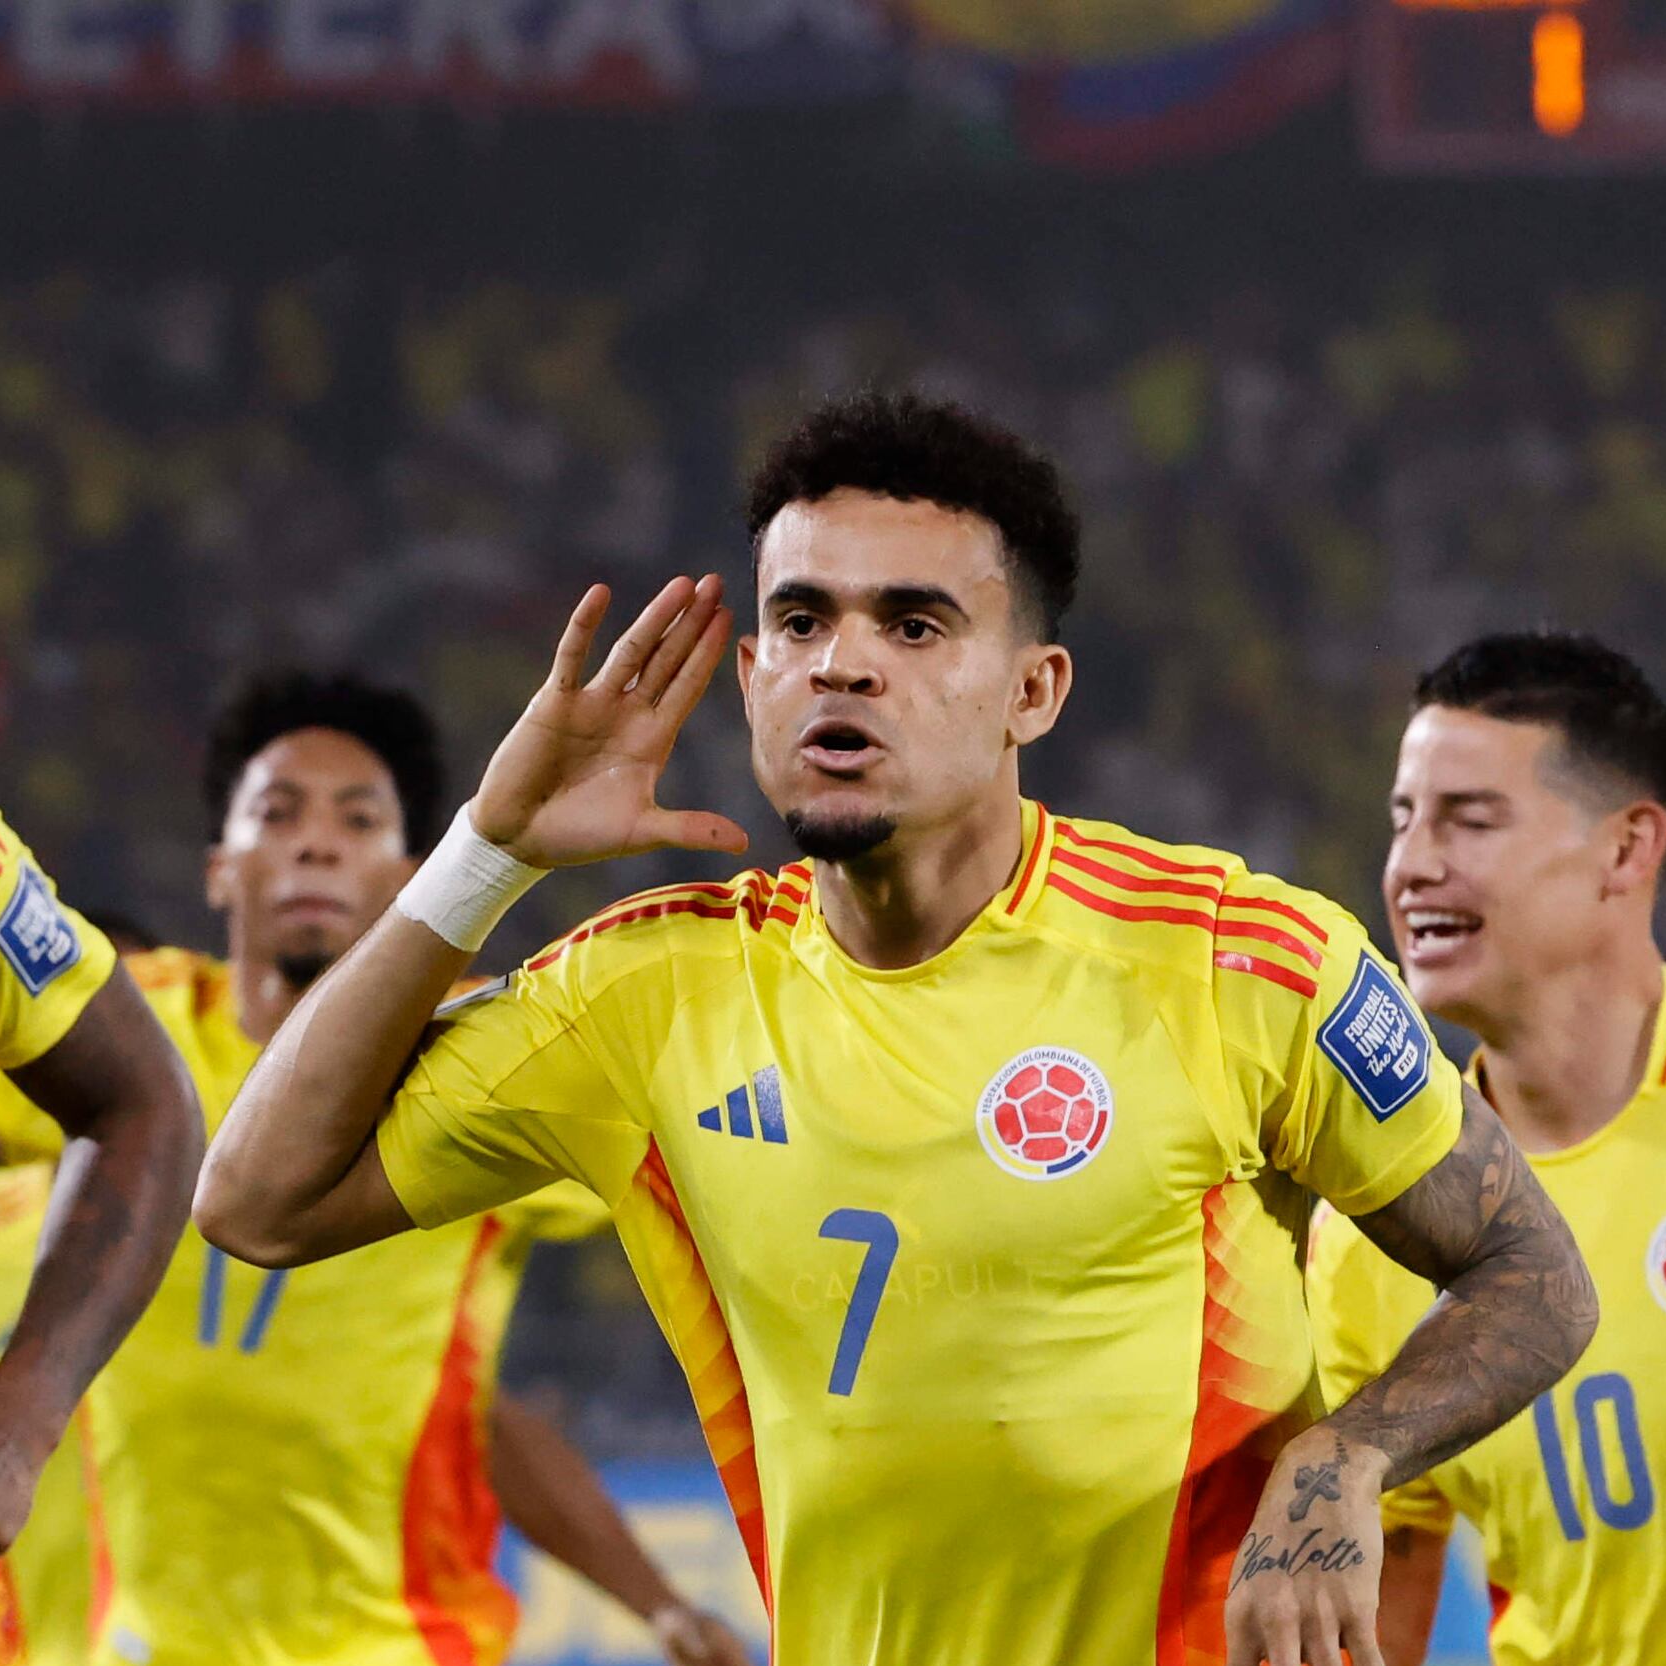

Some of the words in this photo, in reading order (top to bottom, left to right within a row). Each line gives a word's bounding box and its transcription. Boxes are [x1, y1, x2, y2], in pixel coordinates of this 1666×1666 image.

[1344, 984, 1384, 1044] FOOTBALL
[1356, 995, 1399, 1058] UNITES
[1367, 1052, 1392, 1077] the
[819, 1207, 899, 1397] 7
[1532, 1372, 1655, 1542] 10
